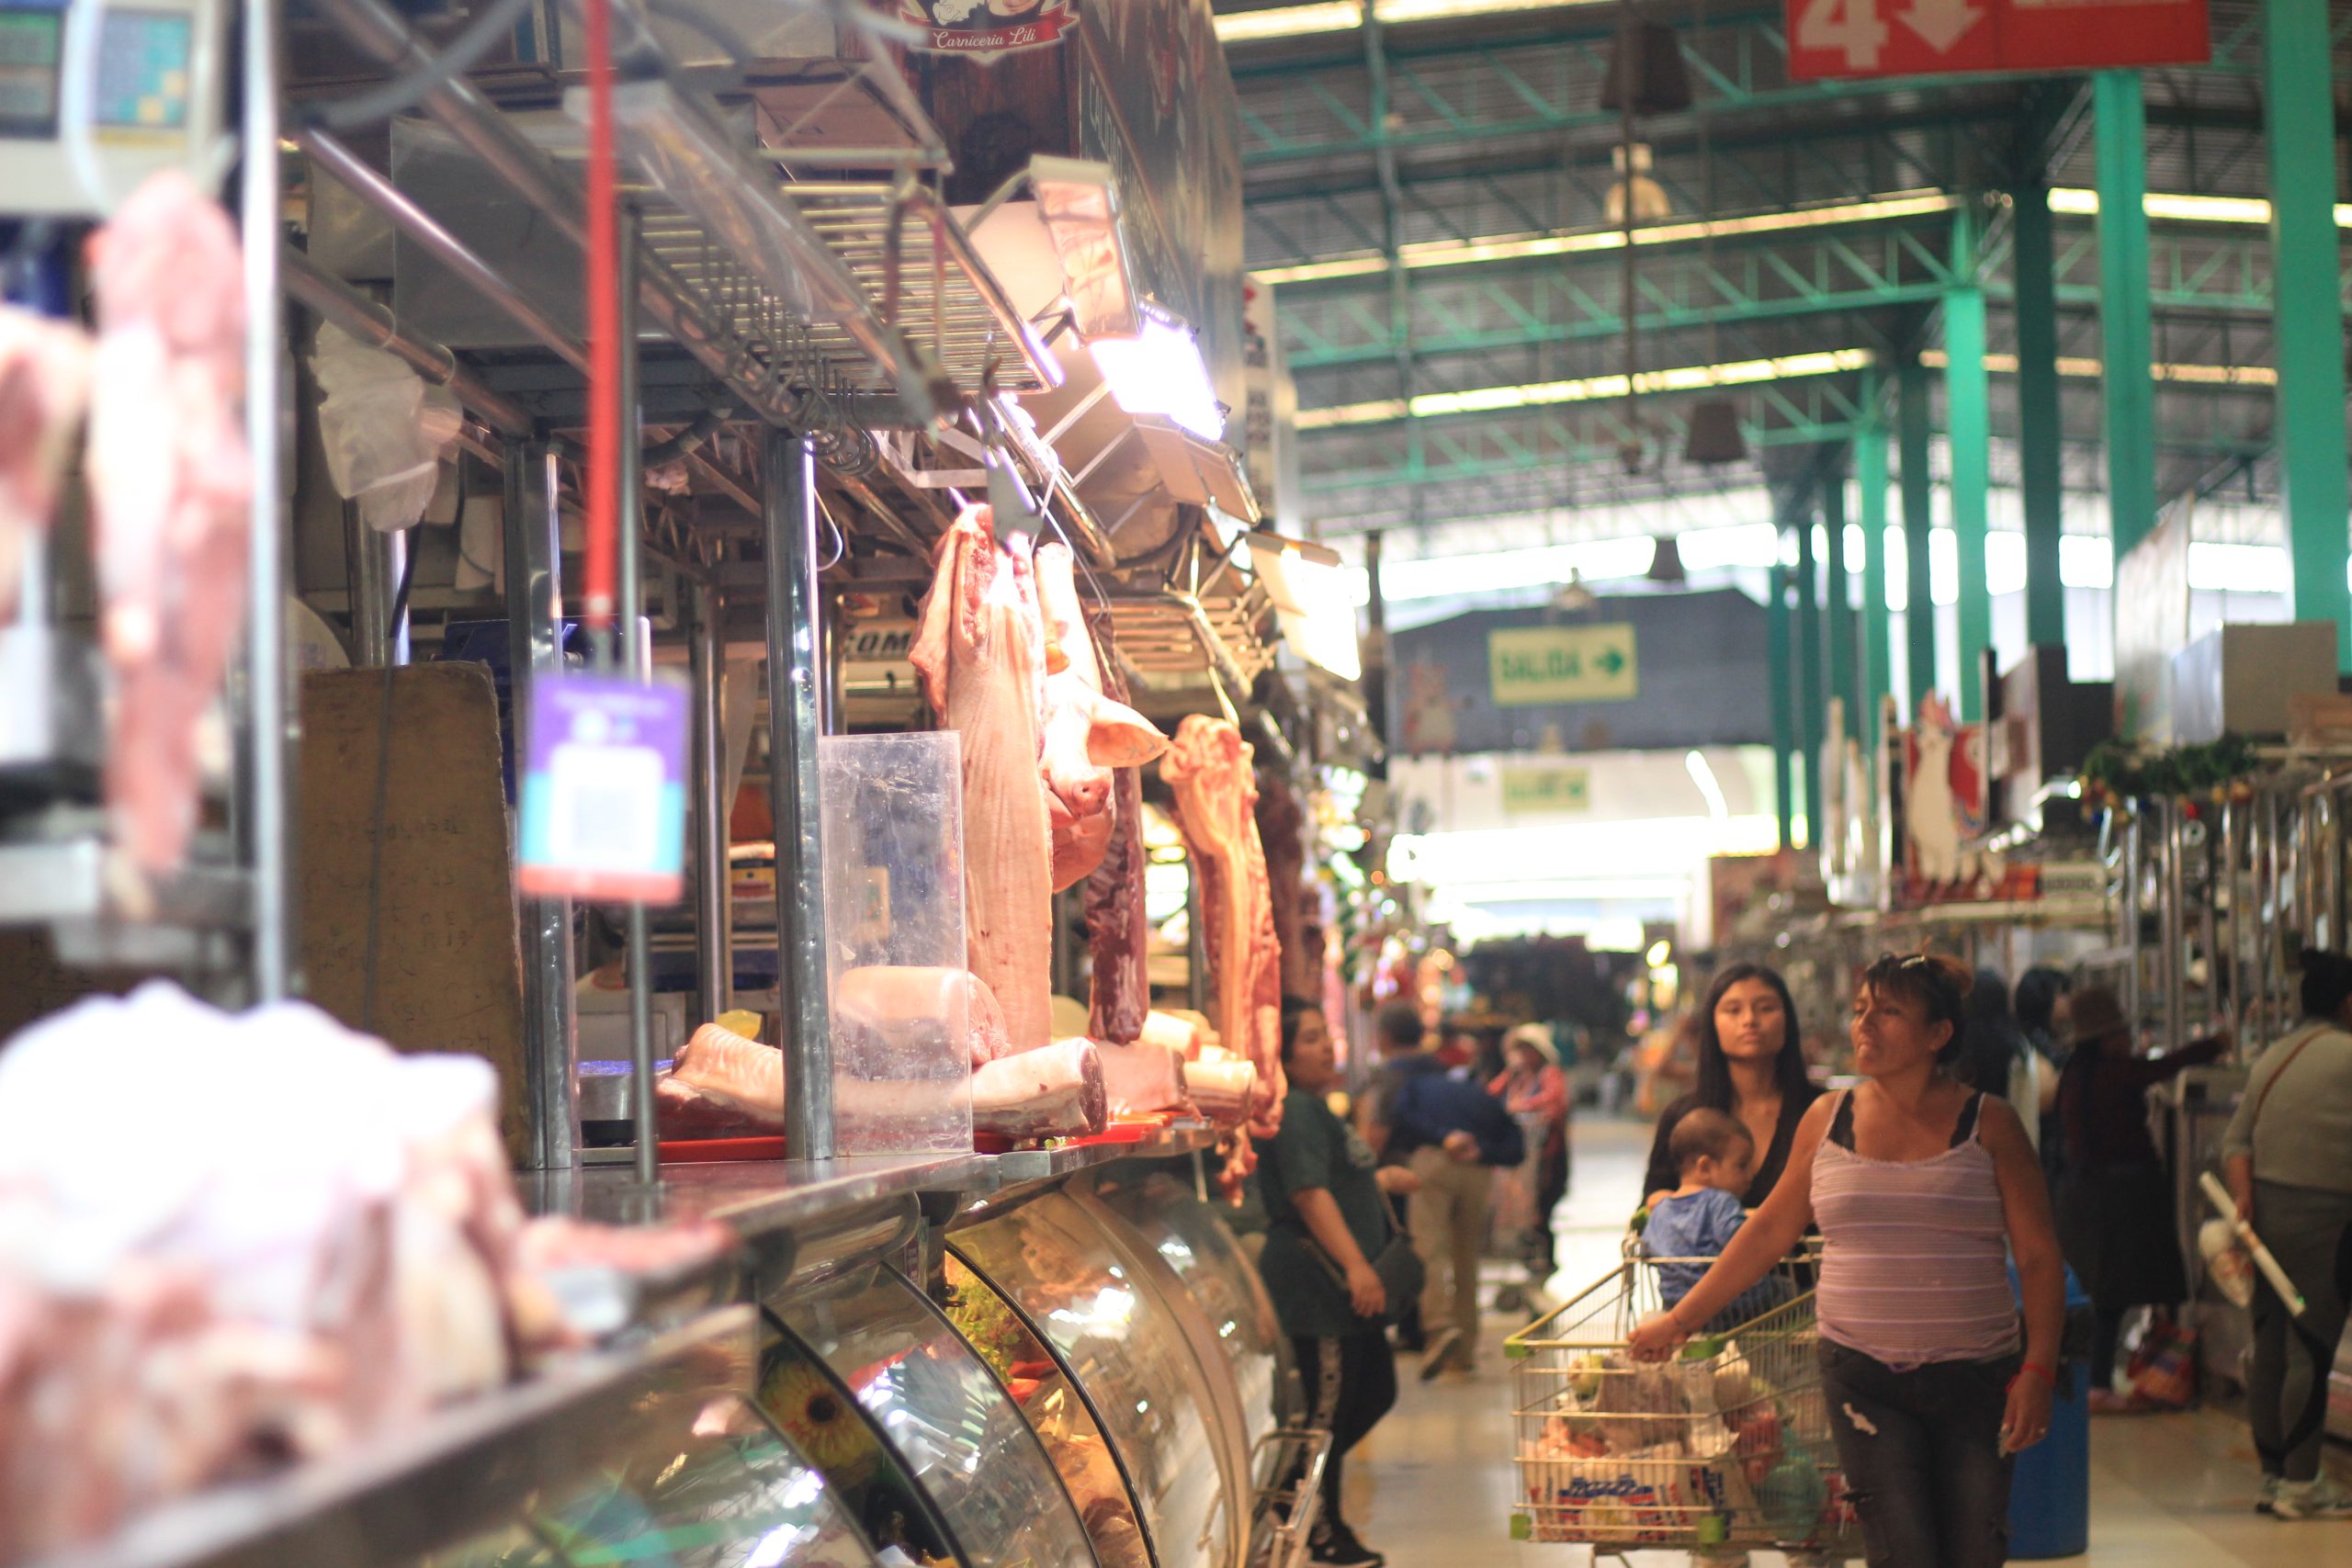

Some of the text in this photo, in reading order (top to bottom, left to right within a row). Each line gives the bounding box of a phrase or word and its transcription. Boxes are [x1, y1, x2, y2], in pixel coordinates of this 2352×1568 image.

[933, 27, 1036, 48] Carniceria Lili
[1797, 0, 1889, 70] 4
